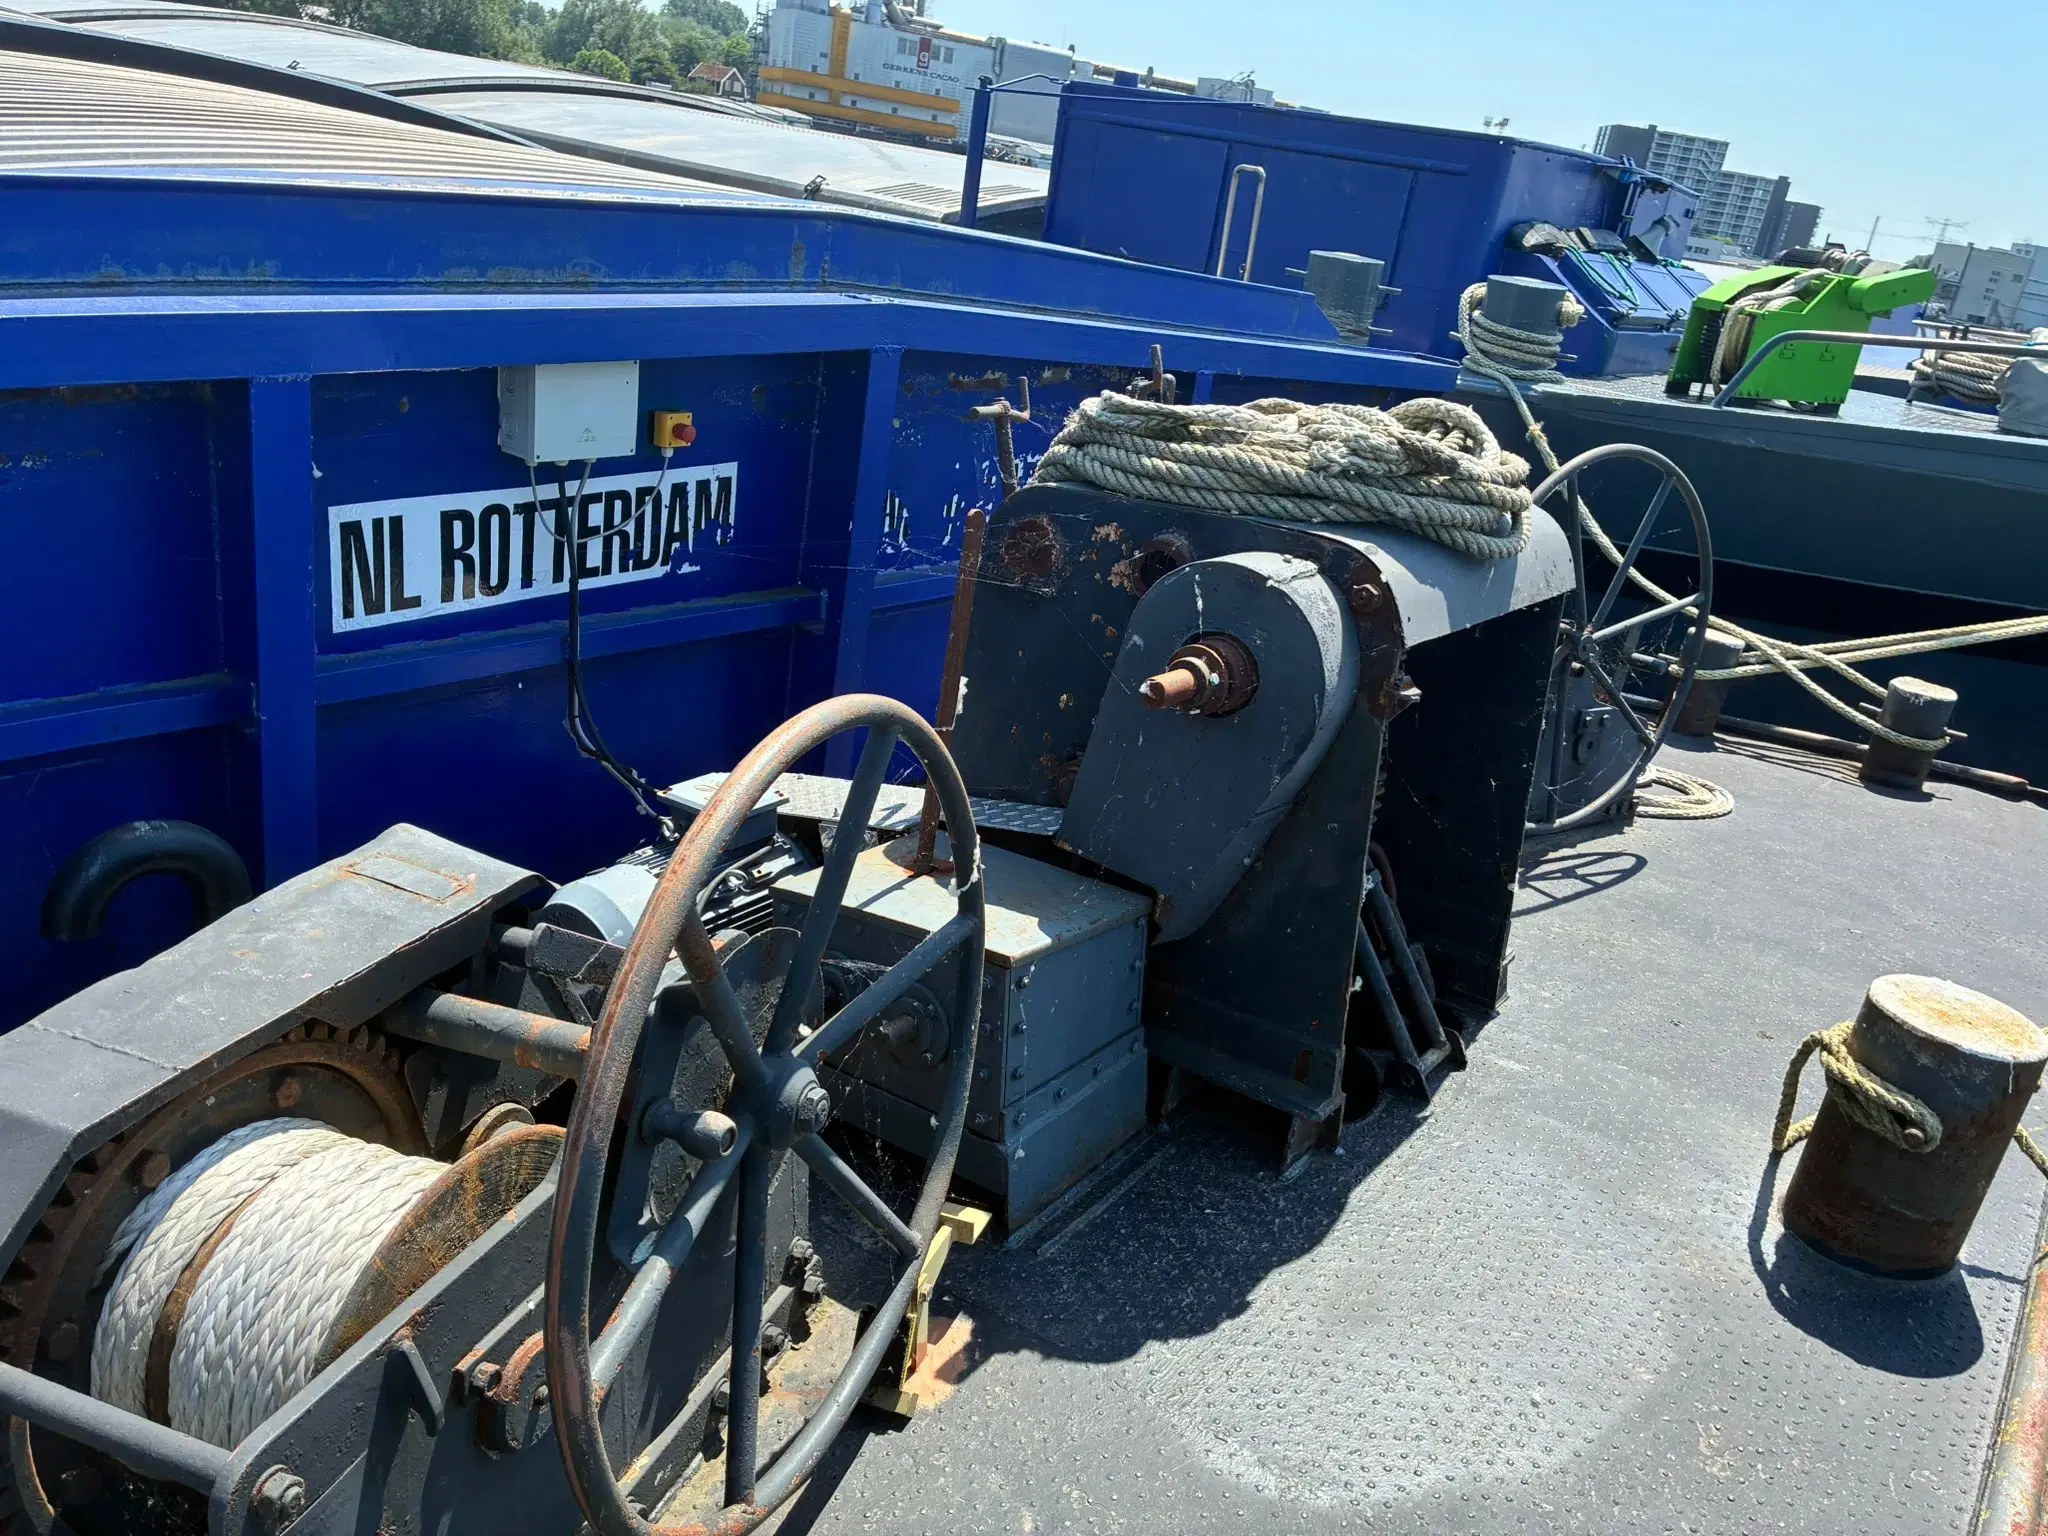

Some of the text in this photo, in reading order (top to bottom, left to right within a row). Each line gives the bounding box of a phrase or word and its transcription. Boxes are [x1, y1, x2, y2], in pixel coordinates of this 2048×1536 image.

[883, 62, 959, 83] GERKENS CACAO
[339, 475, 733, 620] NL ROTTERDAM
